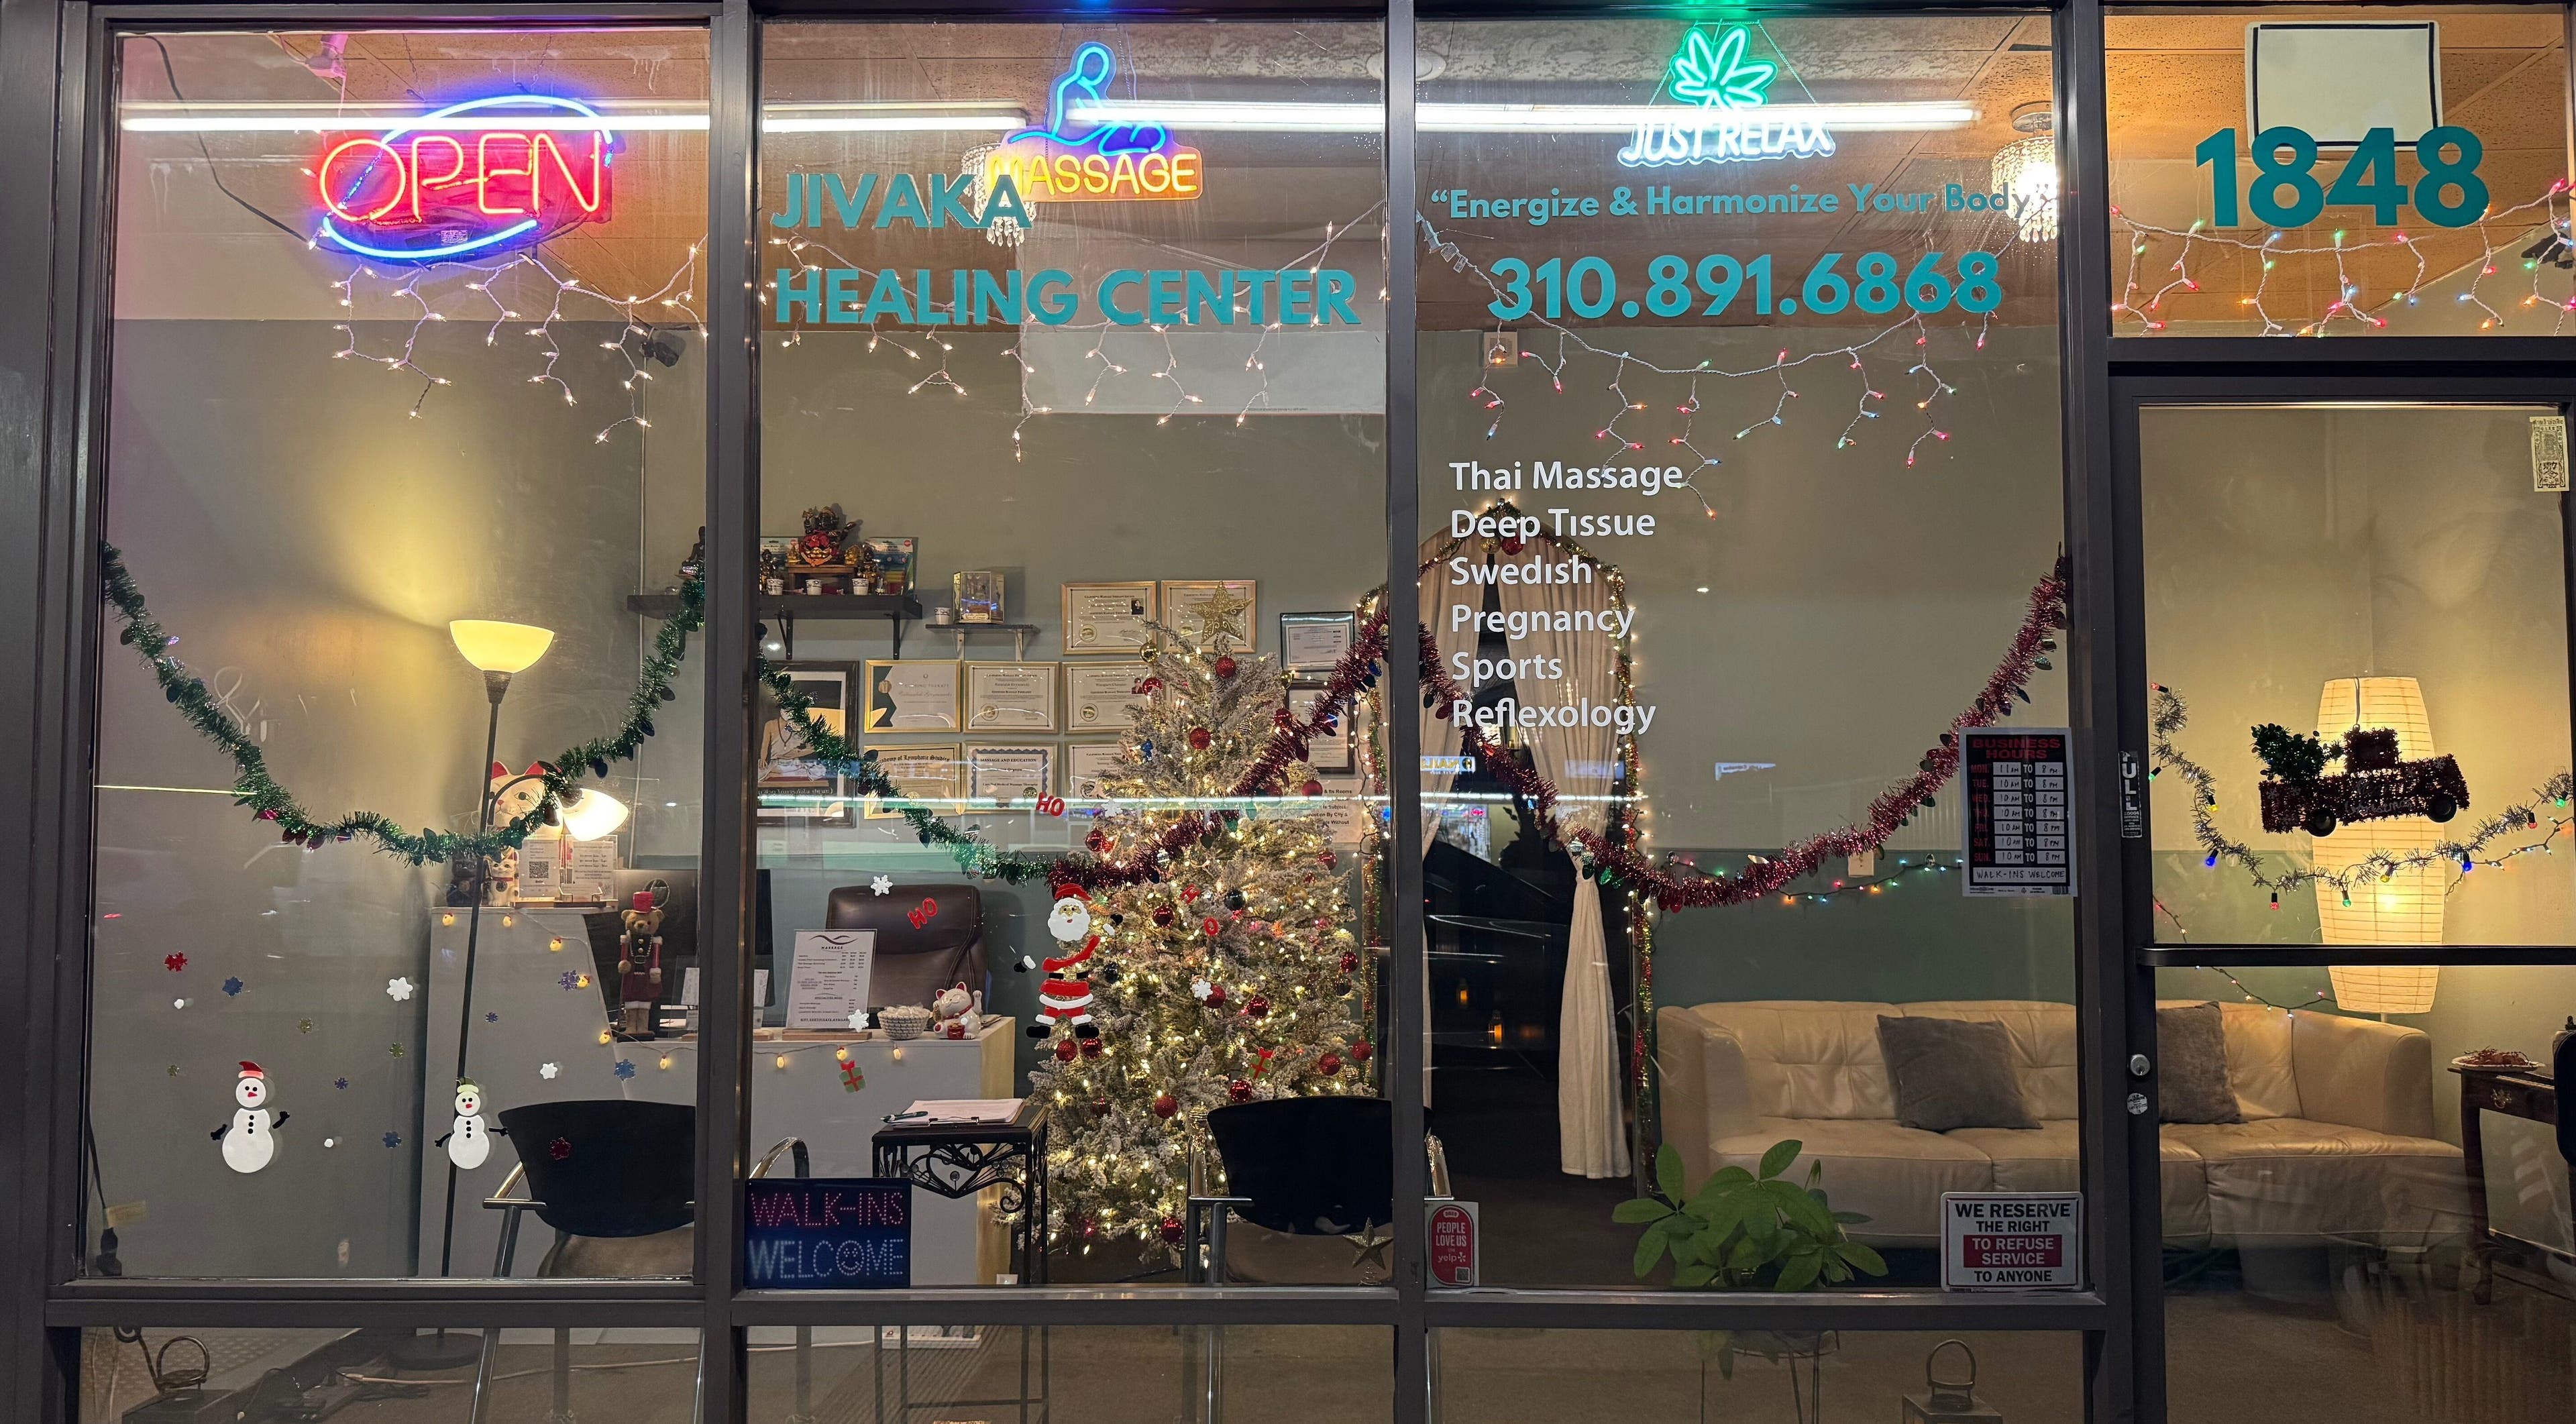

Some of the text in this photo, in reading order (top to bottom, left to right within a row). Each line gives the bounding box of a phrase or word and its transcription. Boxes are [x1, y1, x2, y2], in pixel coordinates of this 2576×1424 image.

[1621, 119, 1831, 162] JUST RELAX
[319, 131, 600, 221] OPEN
[991, 154, 1197, 196] MASSAGE
[2195, 126, 2490, 228] 1848
[770, 173, 1032, 229] JIVAKA
[1611, 187, 1638, 216] &
[1647, 184, 1839, 215] Harmonize
[1847, 184, 1935, 213] Your
[1487, 252, 2004, 319] 310.891.6868
[777, 269, 1362, 325] HEALING CENTER
[1449, 461, 1683, 496] Thai Massage
[1451, 508, 1656, 544] Deep Tissue
[1451, 555, 1592, 584] Swedish
[1452, 604, 1635, 639] Pregnancy
[1452, 651, 1563, 688] Sports
[1452, 698, 1656, 734] Reflexology
[1972, 738, 2060, 749] BUSINESS
[1986, 750, 2047, 759] HOURS
[2023, 764, 2033, 773] TO
[2023, 779, 2033, 787] TO
[1036, 793, 1065, 817] HO
[2024, 793, 2033, 802] TO
[2024, 809, 2033, 817] TO
[2025, 824, 2034, 832] TO
[2025, 838, 2034, 846] TO
[2025, 853, 2035, 861] TO
[1977, 871, 2065, 879] WALK-INS WELCOME
[908, 897, 938, 930] HO
[751, 1192, 904, 1226] WALK-INS
[1955, 1203, 2070, 1217] WE RESERVE
[1437, 1222, 1465, 1234] PEOPLE
[1976, 1221, 2050, 1232] THE RIGHT
[1436, 1236, 1466, 1247] LOVE US
[1972, 1238, 2054, 1250] TO REFUSE
[749, 1239, 904, 1280] WELCOME
[1438, 1254, 1456, 1263] yelp
[1982, 1252, 2045, 1265] SERVICE
[1974, 1270, 2052, 1282] TO ANYONE
